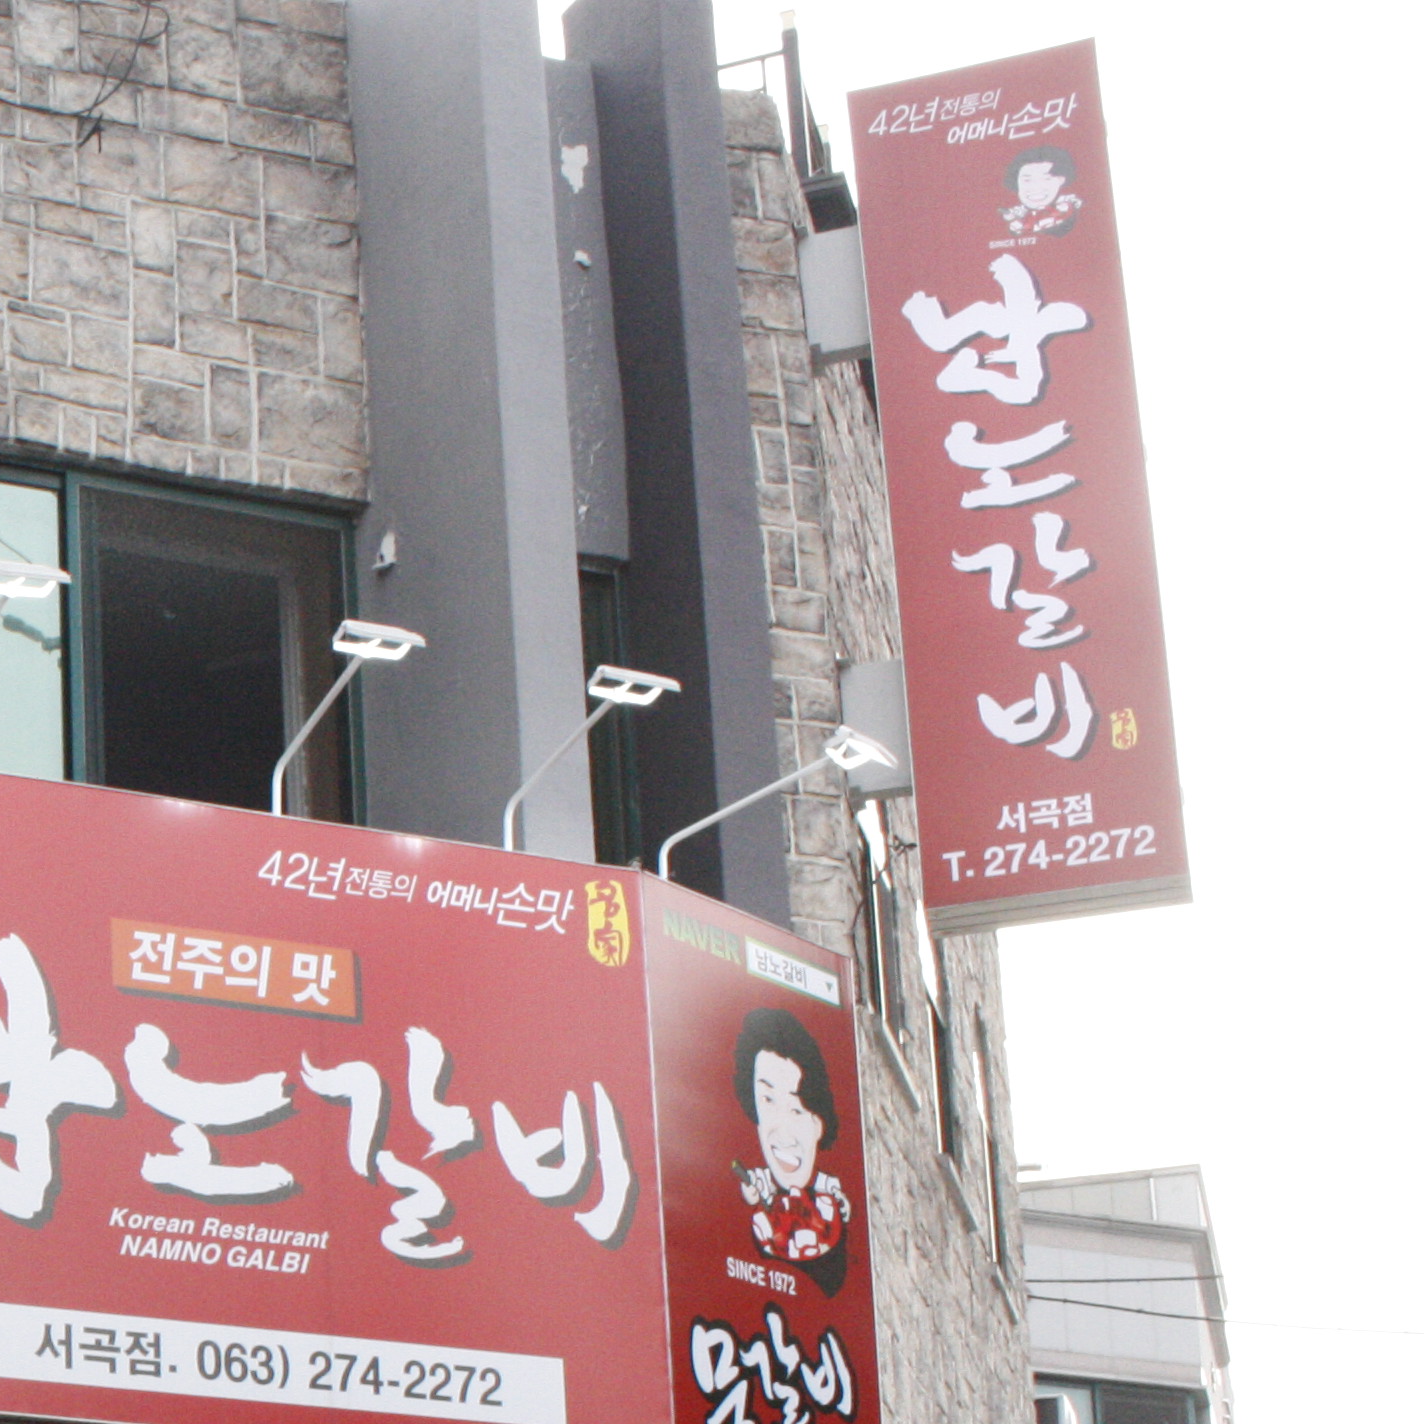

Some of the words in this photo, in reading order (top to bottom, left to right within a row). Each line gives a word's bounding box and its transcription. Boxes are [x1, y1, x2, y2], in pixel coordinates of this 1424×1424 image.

[868, 88, 1002, 136] 42년전통의
[947, 93, 1078, 144] 어머니손맛
[902, 254, 1093, 760] 남노갈비
[997, 793, 1095, 835] 서곡점
[943, 852, 974, 882] T.
[985, 825, 1156, 877] 274-2272
[257, 850, 418, 902] 42년전통의
[427, 880, 575, 935] 어머니손맛
[664, 908, 742, 965] NAVER
[129, 931, 272, 998] 전주의
[292, 953, 336, 1006] 맛
[755, 949, 808, 989] 남노갈비
[109, 1207, 195, 1234] Korean
[201, 1217, 330, 1249] Restaurant
[120, 1234, 222, 1265] NAMNO
[227, 1246, 311, 1274] GALBI
[727, 1257, 765, 1288] SINCE
[768, 1267, 797, 1295] 1972
[35, 1323, 178, 1379] 서곡점.
[196, 1339, 291, 1389] 063)
[308, 1350, 504, 1407] 274-2272
